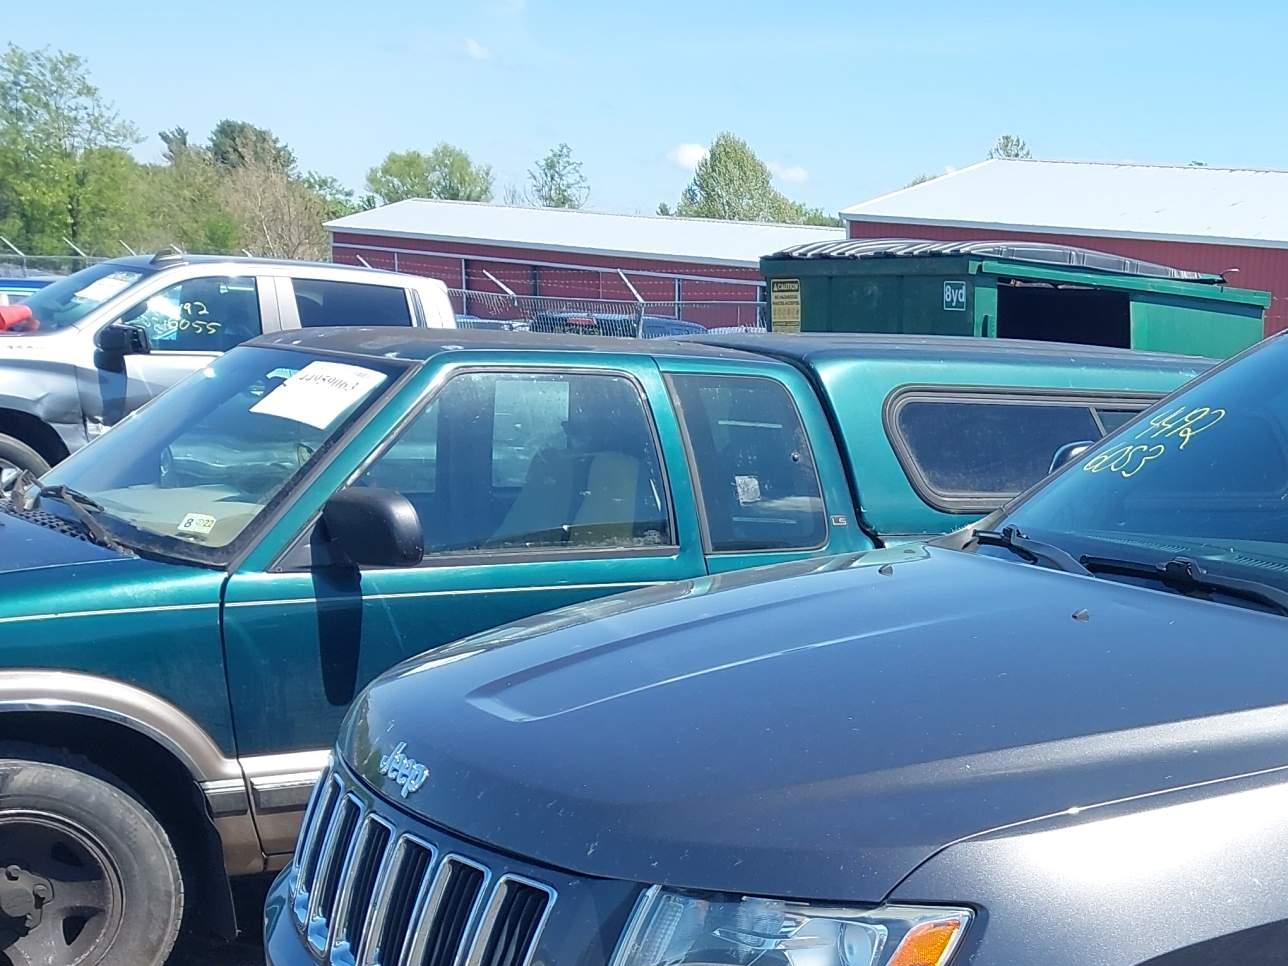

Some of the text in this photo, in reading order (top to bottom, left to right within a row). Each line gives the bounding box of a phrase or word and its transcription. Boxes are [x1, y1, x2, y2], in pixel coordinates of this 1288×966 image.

[945, 285, 965, 306] 8yd
[184, 518, 194, 528] 8
[379, 742, 430, 798] Jeep
